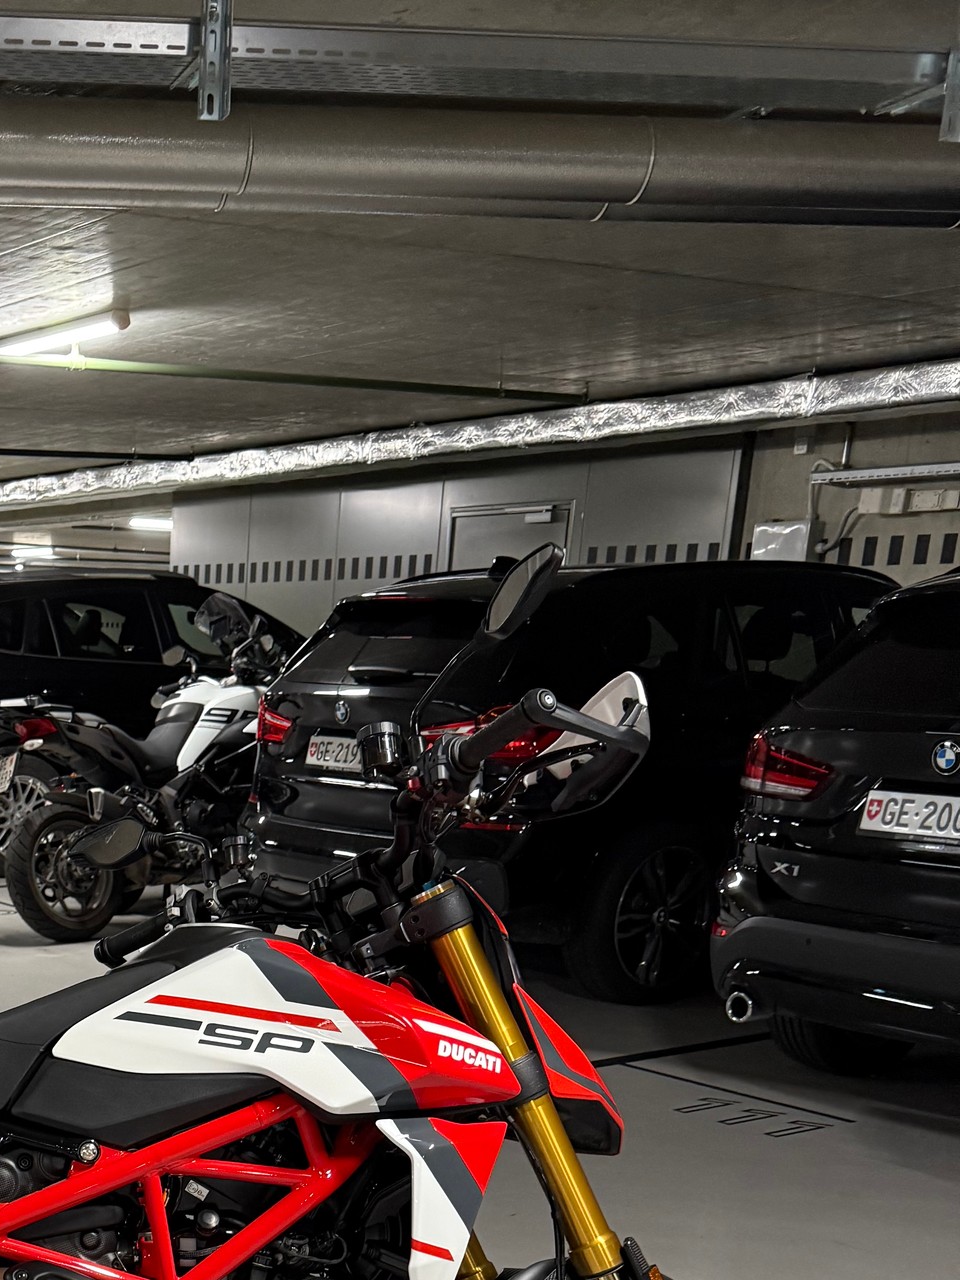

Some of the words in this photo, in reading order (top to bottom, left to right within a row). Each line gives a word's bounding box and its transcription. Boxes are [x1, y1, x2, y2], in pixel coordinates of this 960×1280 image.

[770, 861, 800, 877] X1
[198, 1023, 315, 1054] SP
[437, 1039, 502, 1074] DUCATI
